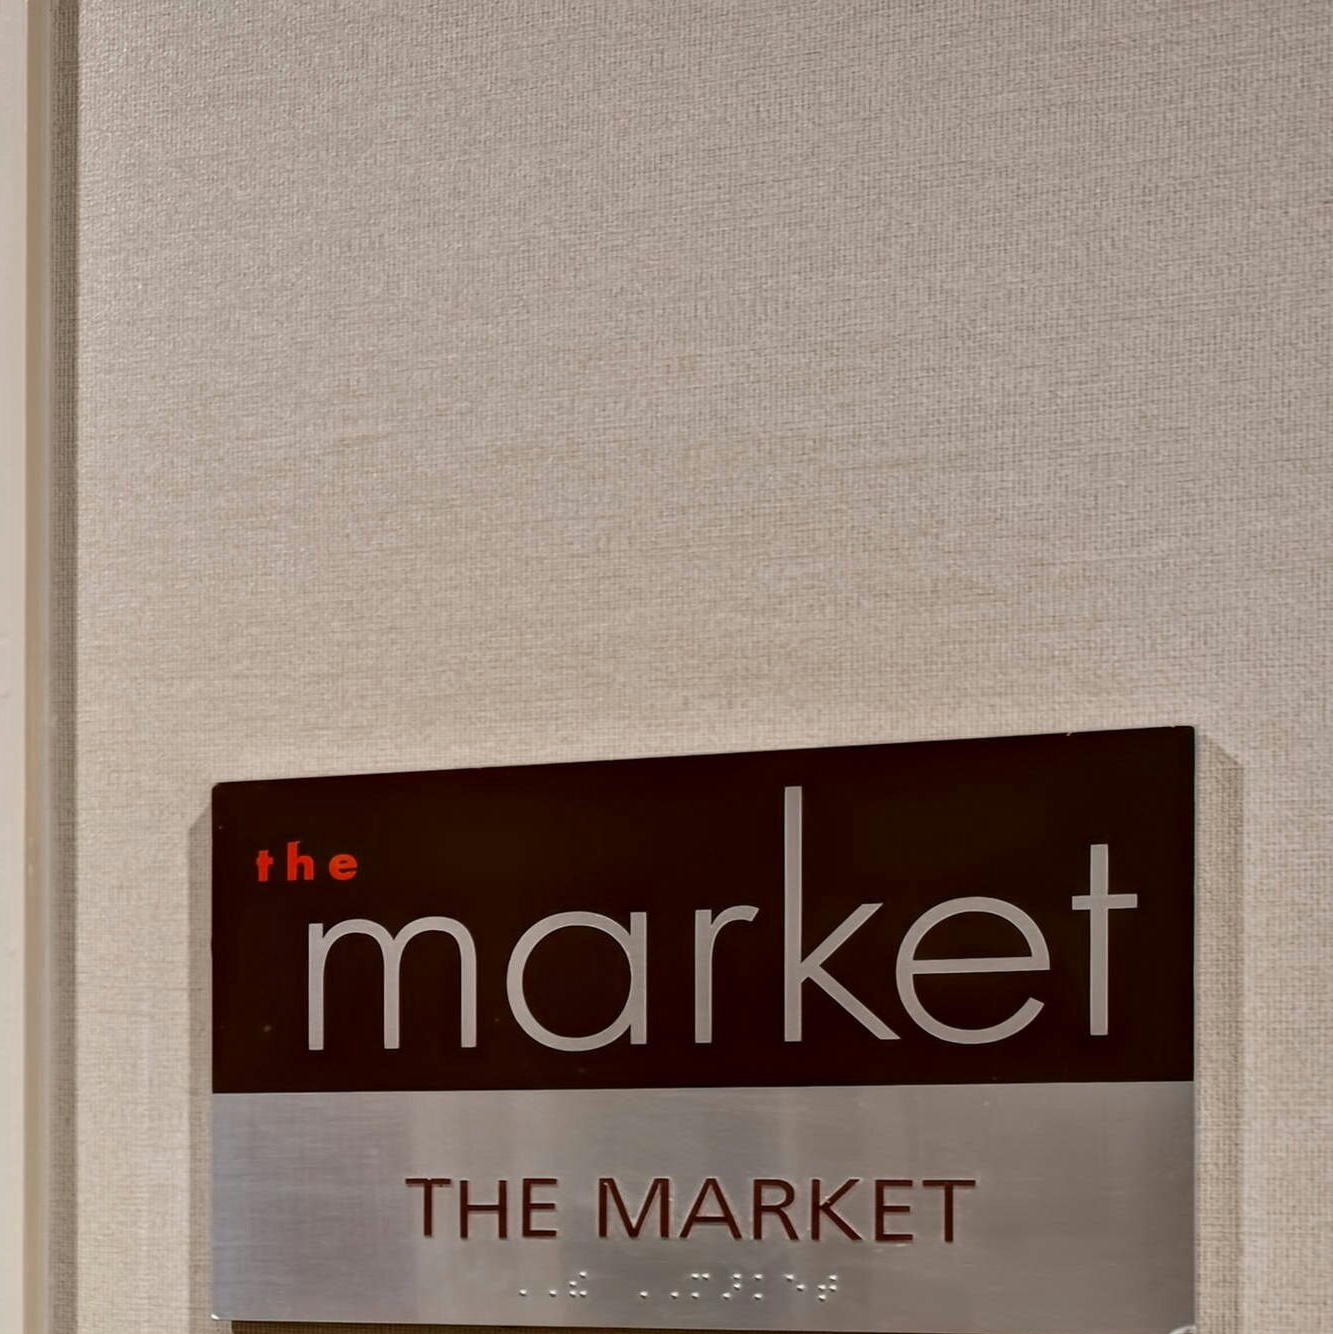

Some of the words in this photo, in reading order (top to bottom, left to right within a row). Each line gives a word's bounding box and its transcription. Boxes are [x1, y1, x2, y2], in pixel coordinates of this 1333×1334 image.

[256, 841, 359, 883] the
[307, 785, 1140, 1053] market
[404, 1177, 560, 1241] THE
[598, 1177, 977, 1245] MARKET
